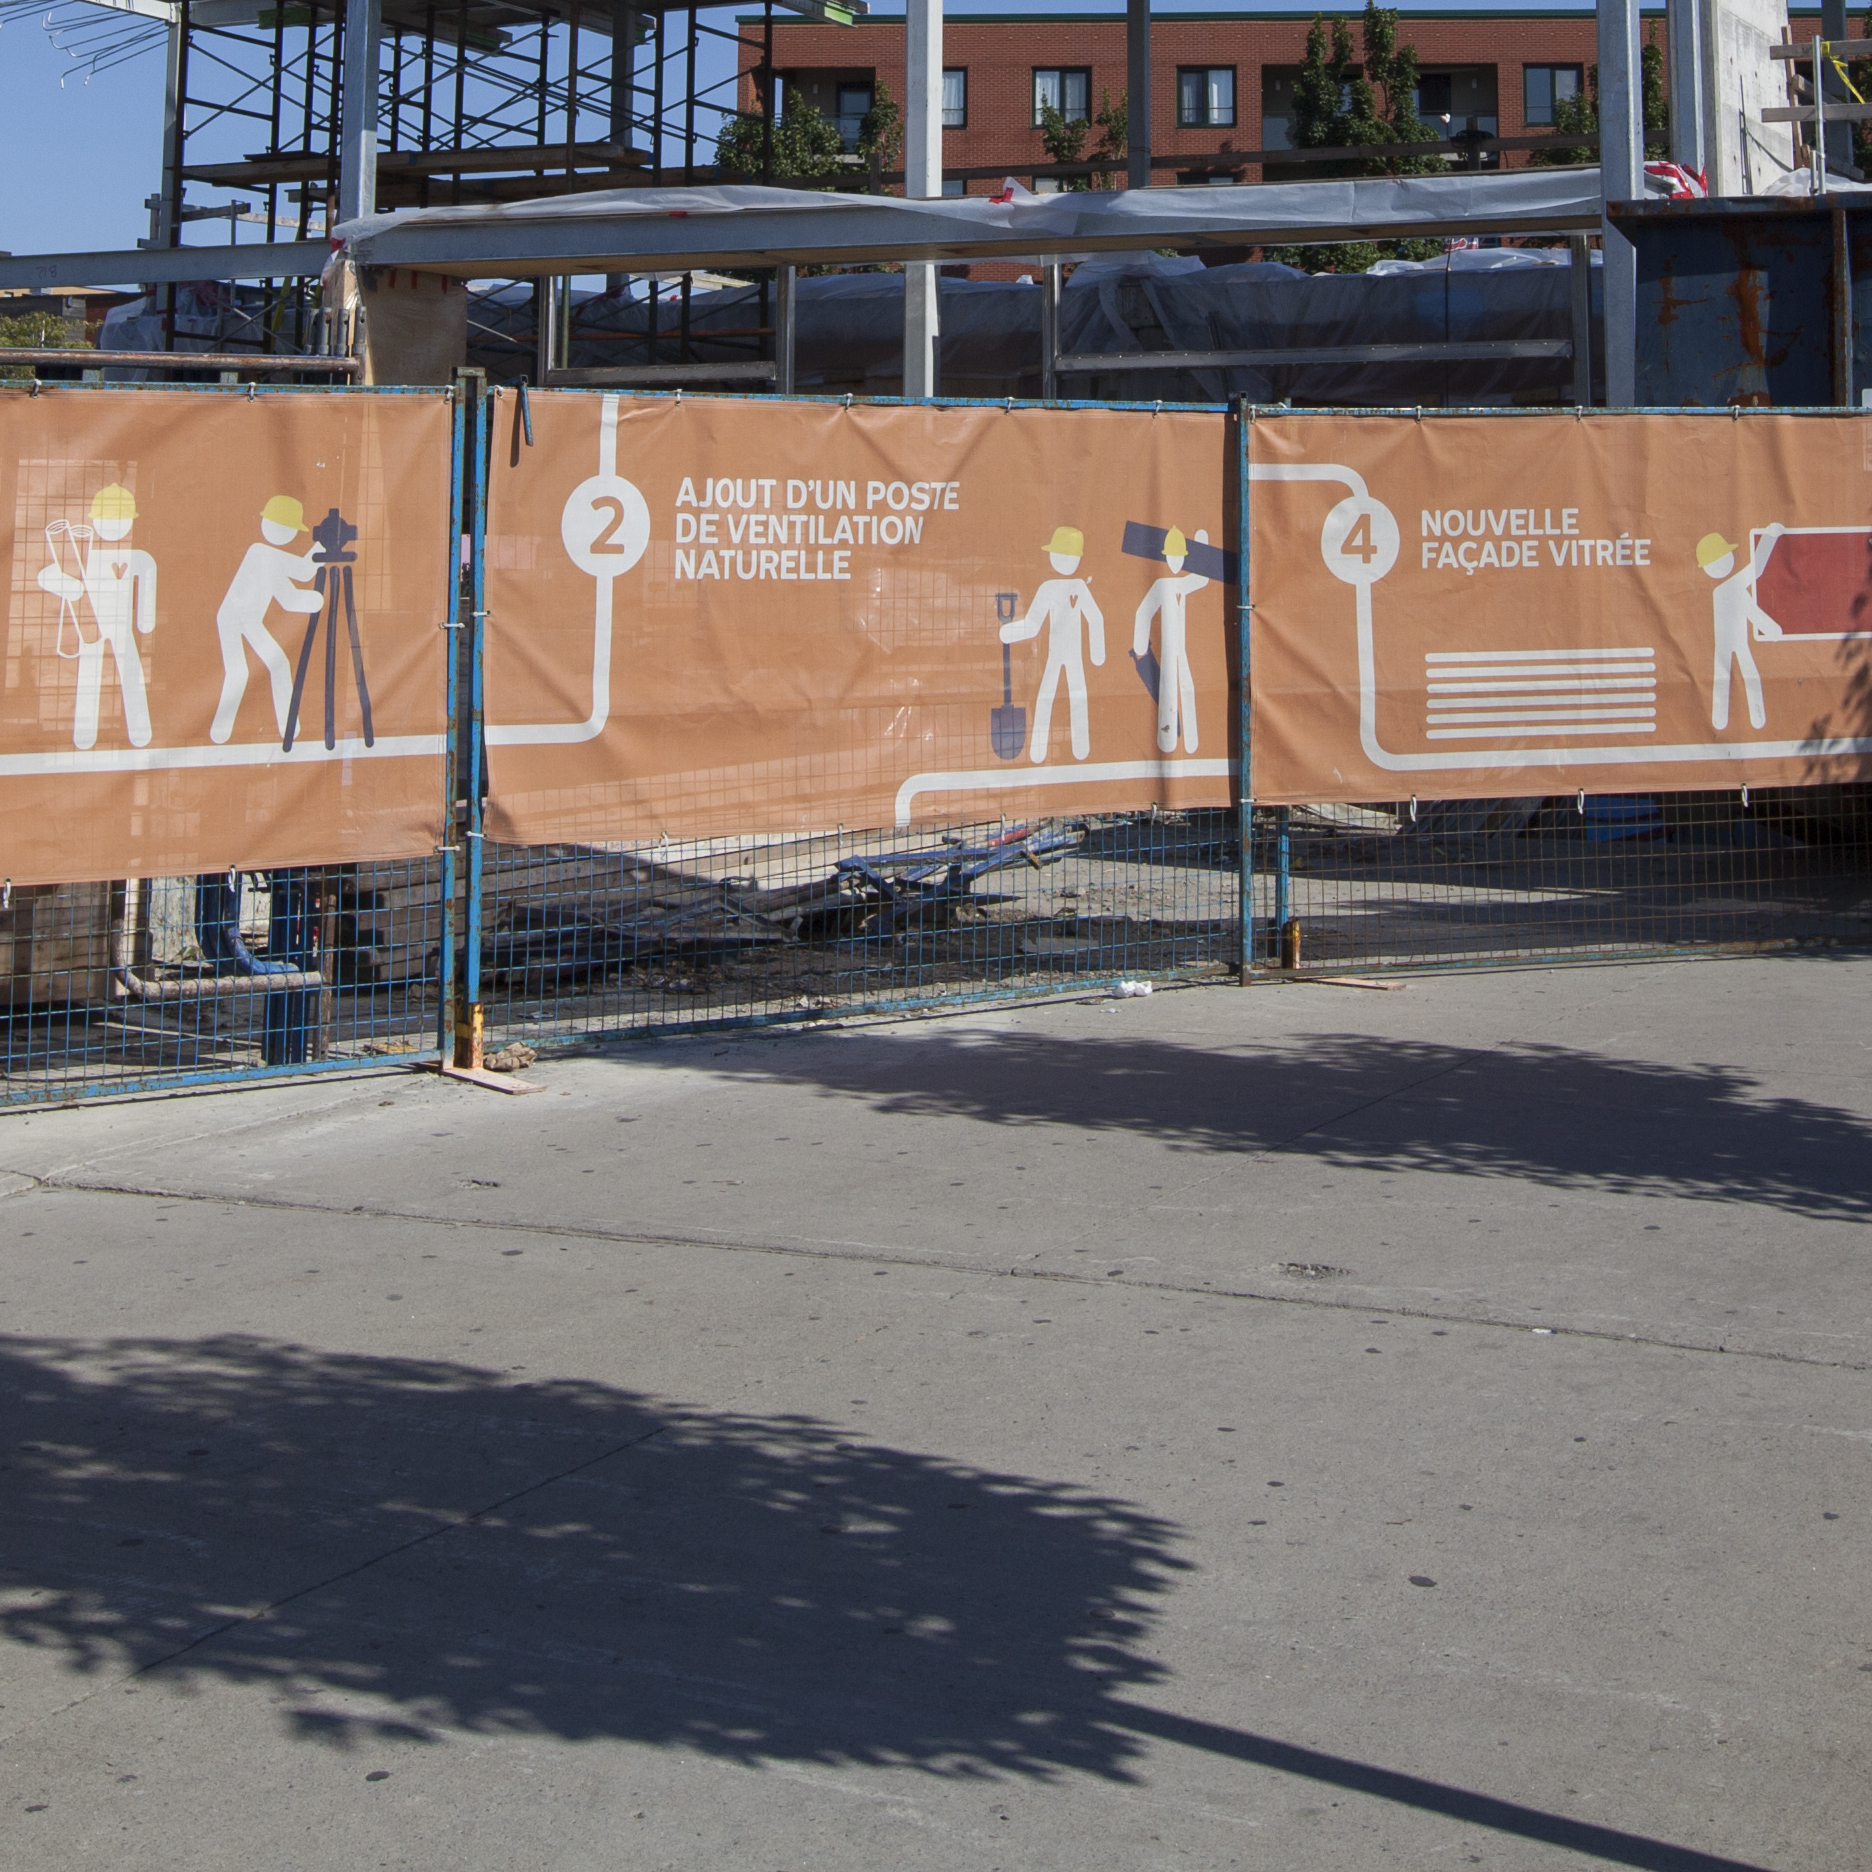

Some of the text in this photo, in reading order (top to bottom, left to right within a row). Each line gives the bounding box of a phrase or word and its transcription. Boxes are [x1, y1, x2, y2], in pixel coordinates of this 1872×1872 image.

[675, 477, 961, 512] AJOUT D'UN POSTE
[589, 495, 626, 556] 2
[675, 513, 924, 545] DE VENTILATION
[1340, 513, 1378, 564] 4
[1421, 508, 1579, 537] NOUVELLE
[674, 549, 852, 580] NATURELLE
[1422, 532, 1651, 576] FAÇADE VITRÉE
